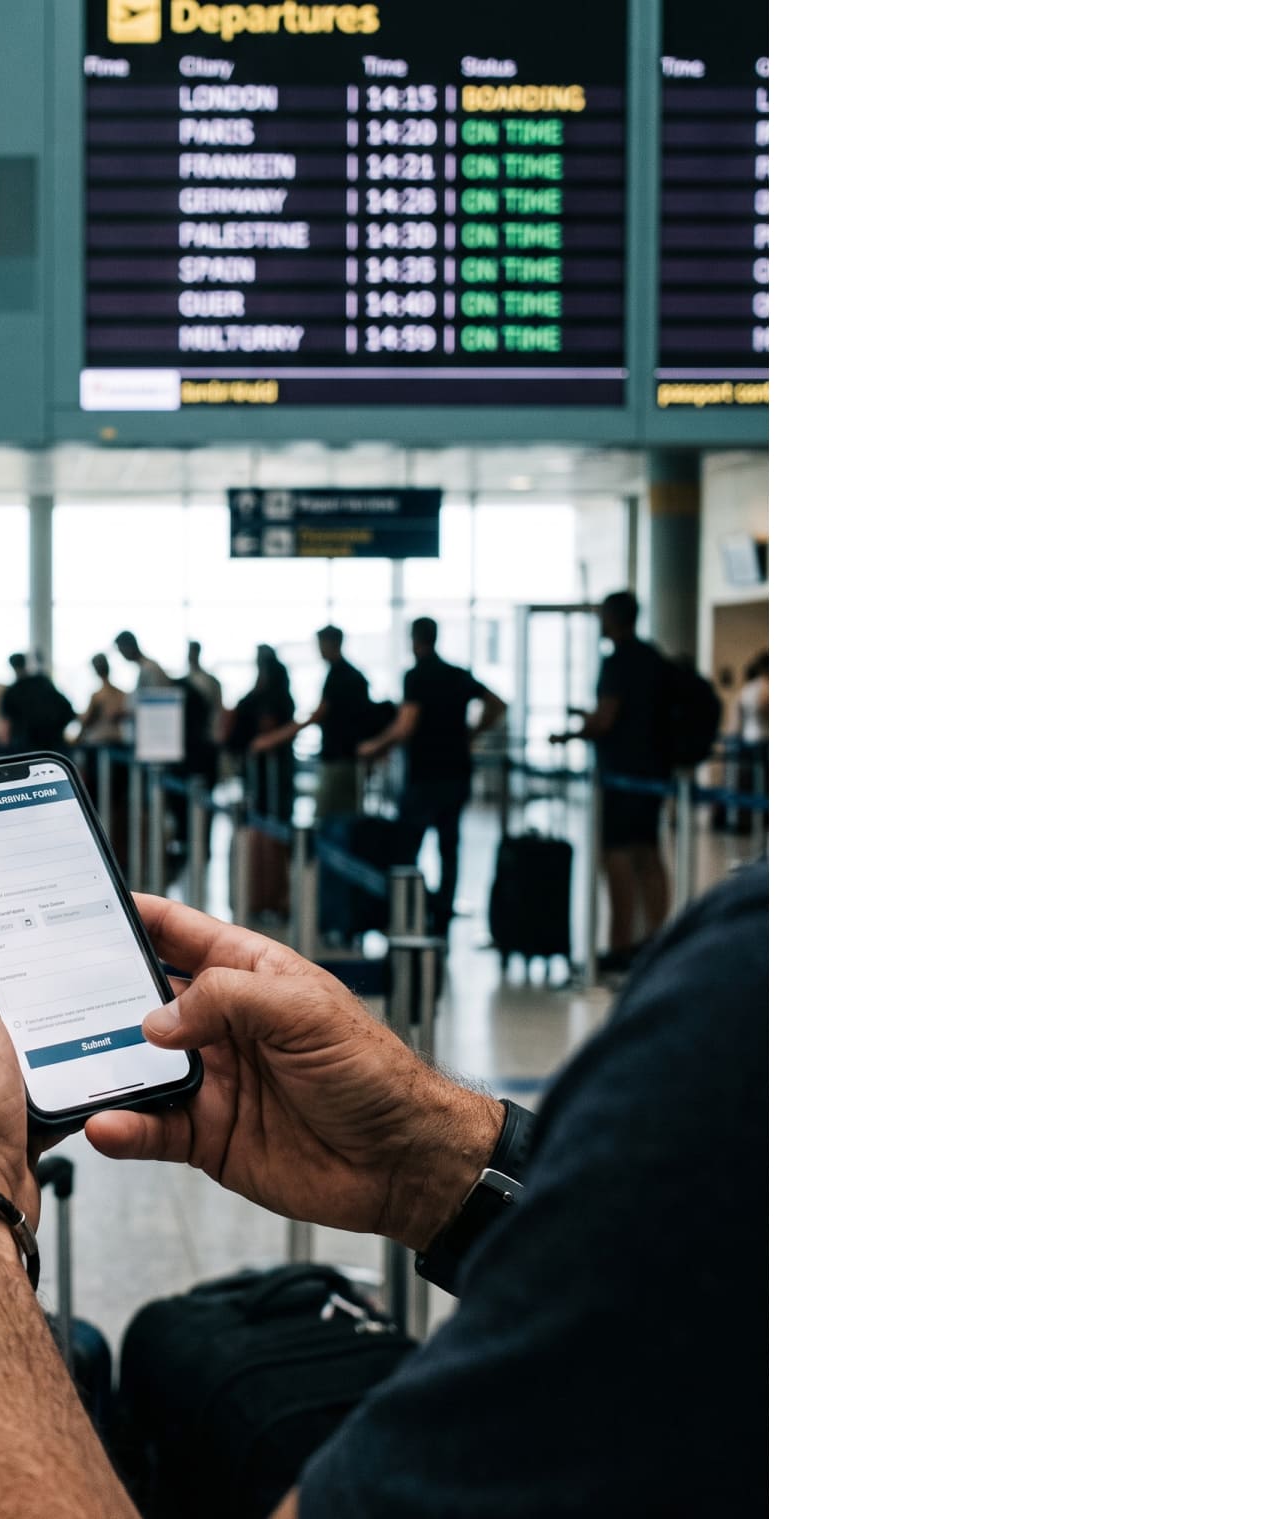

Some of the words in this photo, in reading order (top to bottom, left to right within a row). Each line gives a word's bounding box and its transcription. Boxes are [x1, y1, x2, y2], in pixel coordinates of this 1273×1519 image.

[170, 0, 379, 41] Departures
[178, 85, 278, 112] LONDON
[366, 85, 437, 112] 14:15
[461, 85, 585, 112] BOARDING
[178, 118, 255, 146] PARIS
[366, 118, 437, 146] 14:20
[461, 119, 499, 146] ON
[502, 119, 562, 146] TIME
[366, 153, 437, 180] 14:21
[461, 154, 499, 180] ON
[502, 154, 562, 180] TIME
[461, 188, 499, 214] ON
[502, 188, 562, 214] TIME
[178, 222, 310, 249] PALESTINE
[461, 223, 499, 249] ON
[502, 223, 562, 249] TIME
[178, 256, 256, 283] SPAIN
[461, 257, 499, 283] ON
[502, 257, 562, 283] TIME
[366, 290, 437, 317] 14:40
[461, 291, 499, 317] ON
[502, 291, 562, 317] TIME
[461, 326, 499, 352] ON
[502, 326, 562, 352] TIME
[33, 788, 58, 800] FORM
[81, 1036, 112, 1051] Submit
